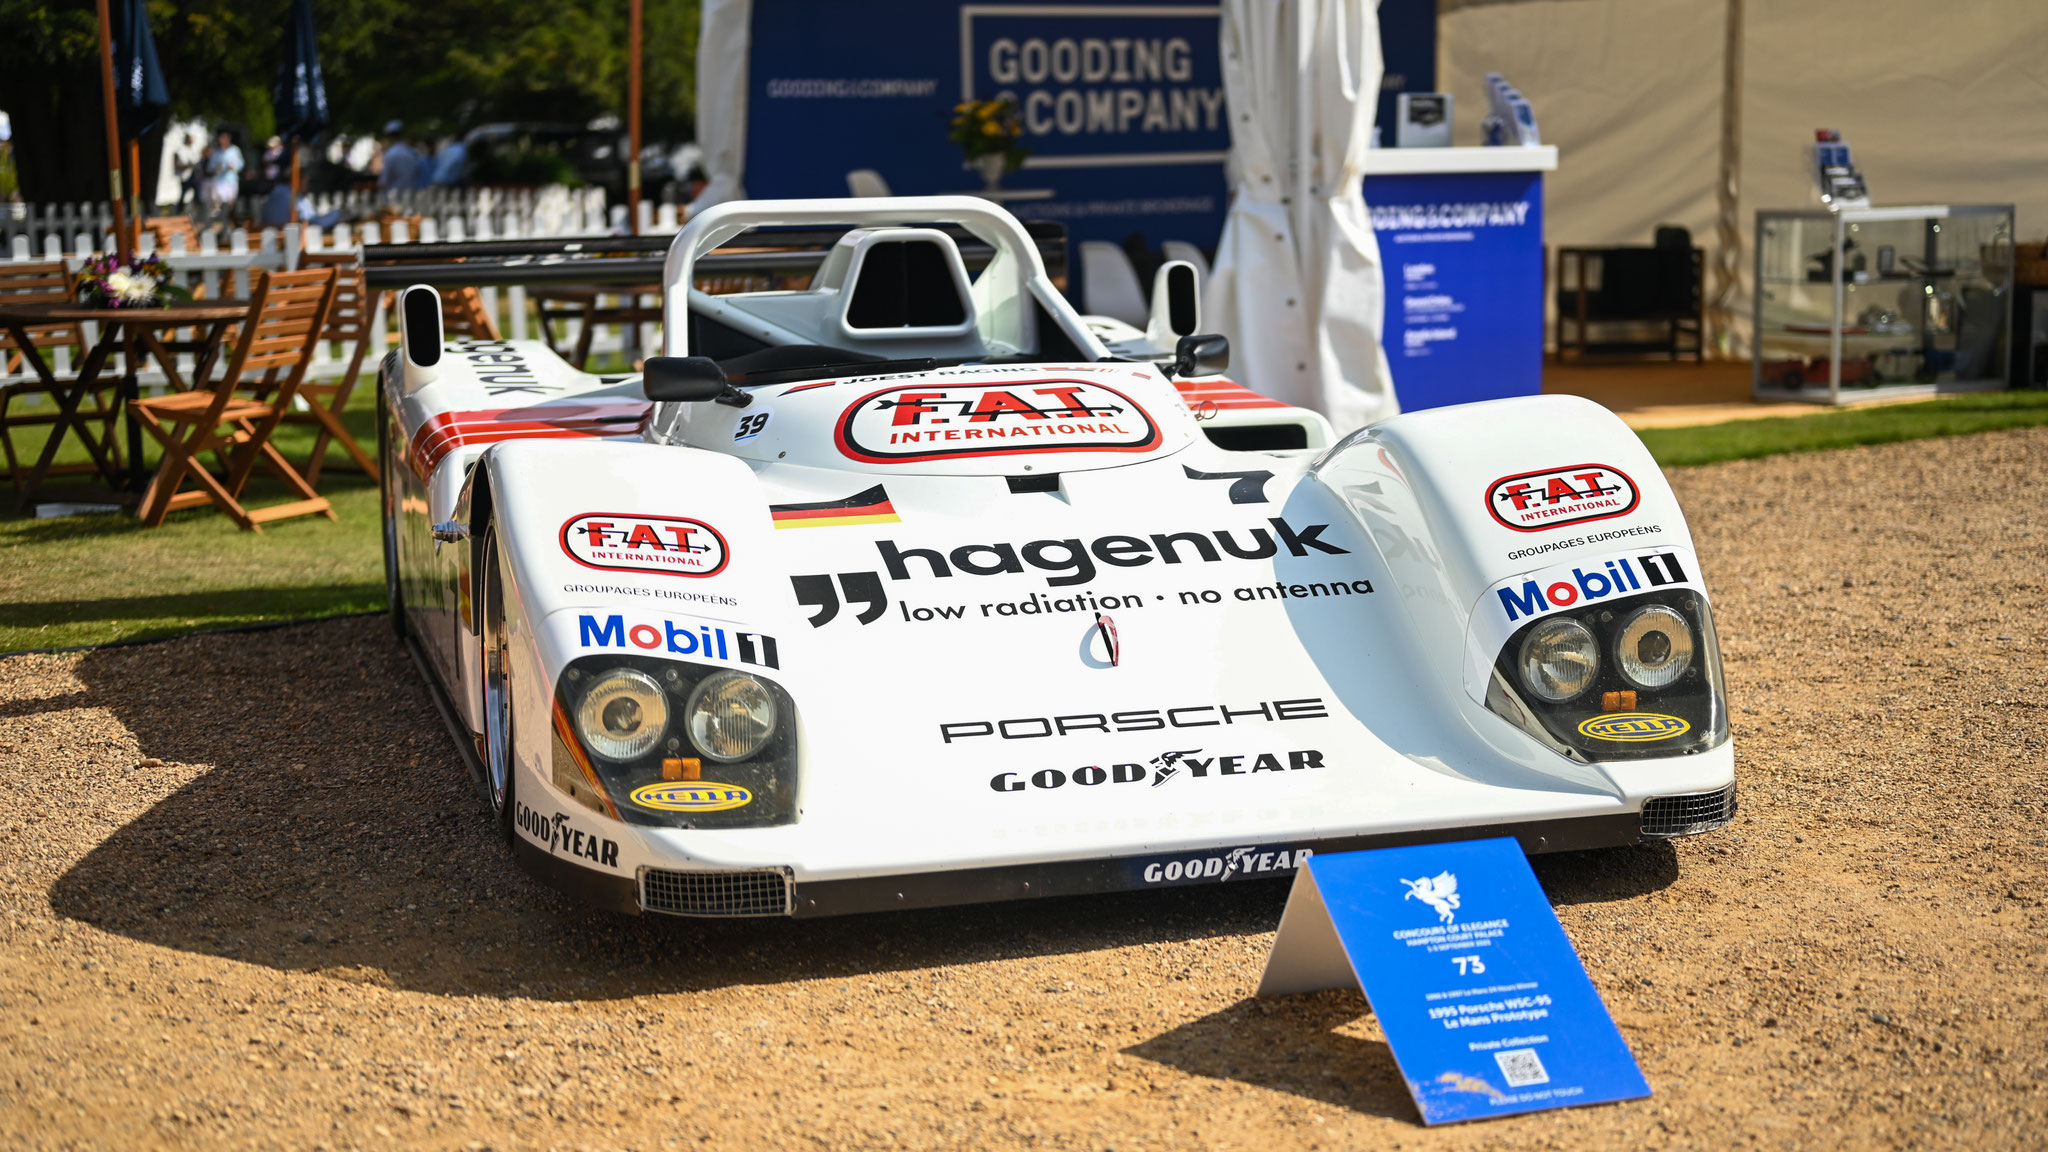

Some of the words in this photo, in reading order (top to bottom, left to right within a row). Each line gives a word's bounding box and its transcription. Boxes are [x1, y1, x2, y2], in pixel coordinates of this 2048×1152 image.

[989, 38, 1192, 83] GOODING
[843, 371, 927, 385] JOEST
[938, 366, 1038, 378] RACING
[734, 413, 770, 439] 39
[890, 423, 1129, 445] INTERNATIONAL
[1520, 498, 1621, 522] INTERNATIONAL
[592, 551, 704, 567] INTERNATIONAL
[876, 516, 1351, 587] hagenuk
[1508, 536, 1585, 561] GROUPAGES
[563, 584, 651, 597] GROUPAGES
[900, 599, 970, 622] low
[980, 588, 1143, 618] radiation
[1179, 587, 1222, 604] no
[1233, 577, 1374, 601] antenna
[1497, 558, 1641, 622] Mobil
[1649, 555, 1675, 584] 1
[579, 614, 728, 660] Mobil
[940, 698, 1329, 744] PORSCHE
[1592, 717, 1685, 736] HELLA
[644, 790, 749, 802] HELLA
[1393, 926, 1446, 940] CONCOURS
[1447, 923, 1459, 933] OF
[1461, 918, 1509, 932] ELEGANCE
[1406, 936, 1446, 947] HAMPTON
[1447, 932, 1474, 942] COURT
[1474, 928, 1504, 939] PALACE
[1438, 941, 1475, 952] SEPTEMBER
[1451, 955, 1486, 976] 73
[1428, 1005, 1458, 1019] 1995
[1458, 1000, 1505, 1016] Porsche
[1505, 994, 1552, 1010] WSC-95
[1443, 1018, 1459, 1029] Le
[1459, 1014, 1491, 1028] Mans
[1491, 1008, 1548, 1023] Prototype
[1468, 1041, 1501, 1051] Private
[1501, 1034, 1549, 1048] Collection
